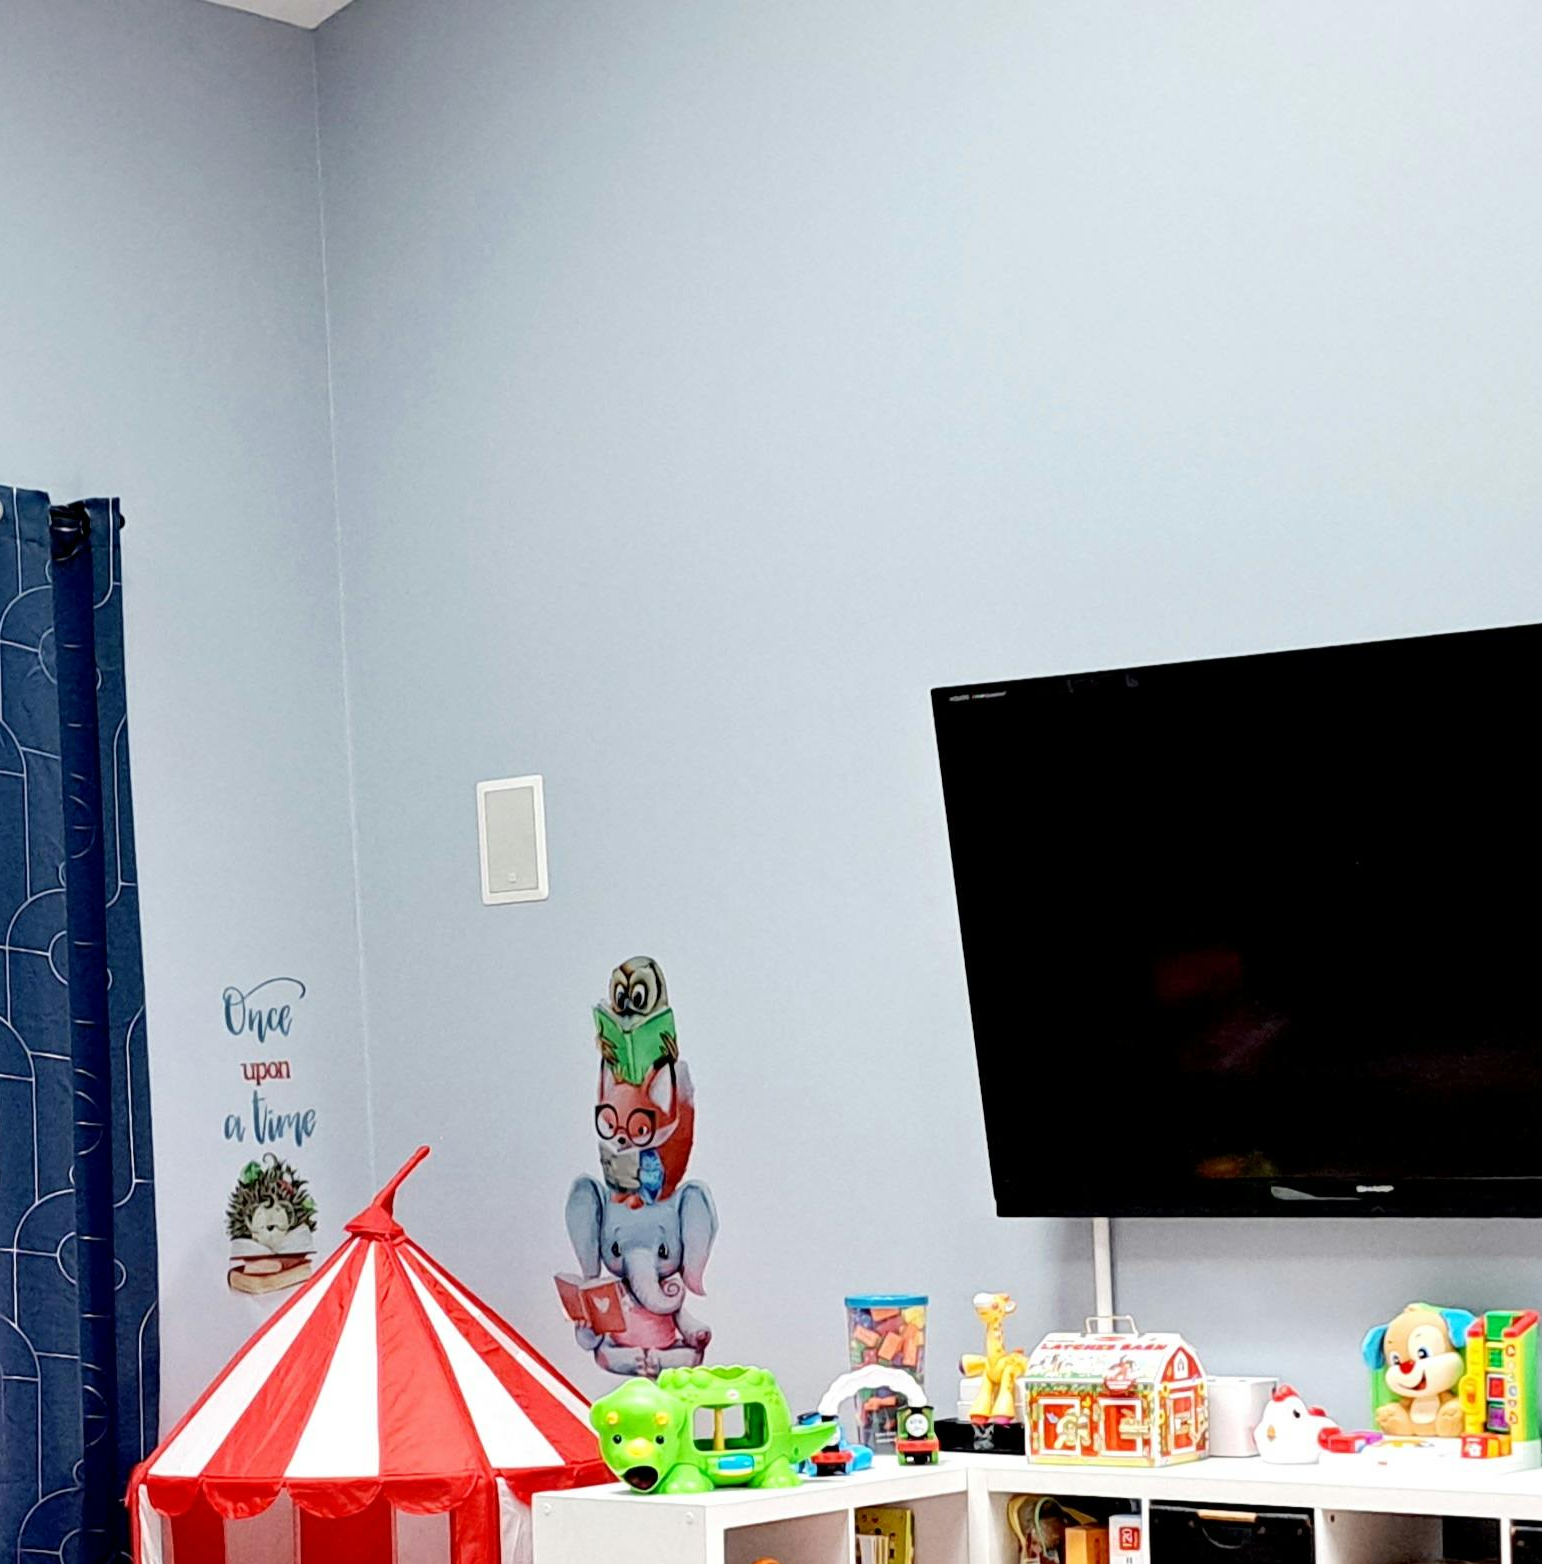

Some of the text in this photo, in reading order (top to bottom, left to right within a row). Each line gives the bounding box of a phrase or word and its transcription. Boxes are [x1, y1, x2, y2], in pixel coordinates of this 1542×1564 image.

[222, 977, 306, 1043] Once
[242, 1060, 291, 1086] upon
[224, 1089, 317, 1148] a time
[1119, 1343, 1169, 1351] BARN
